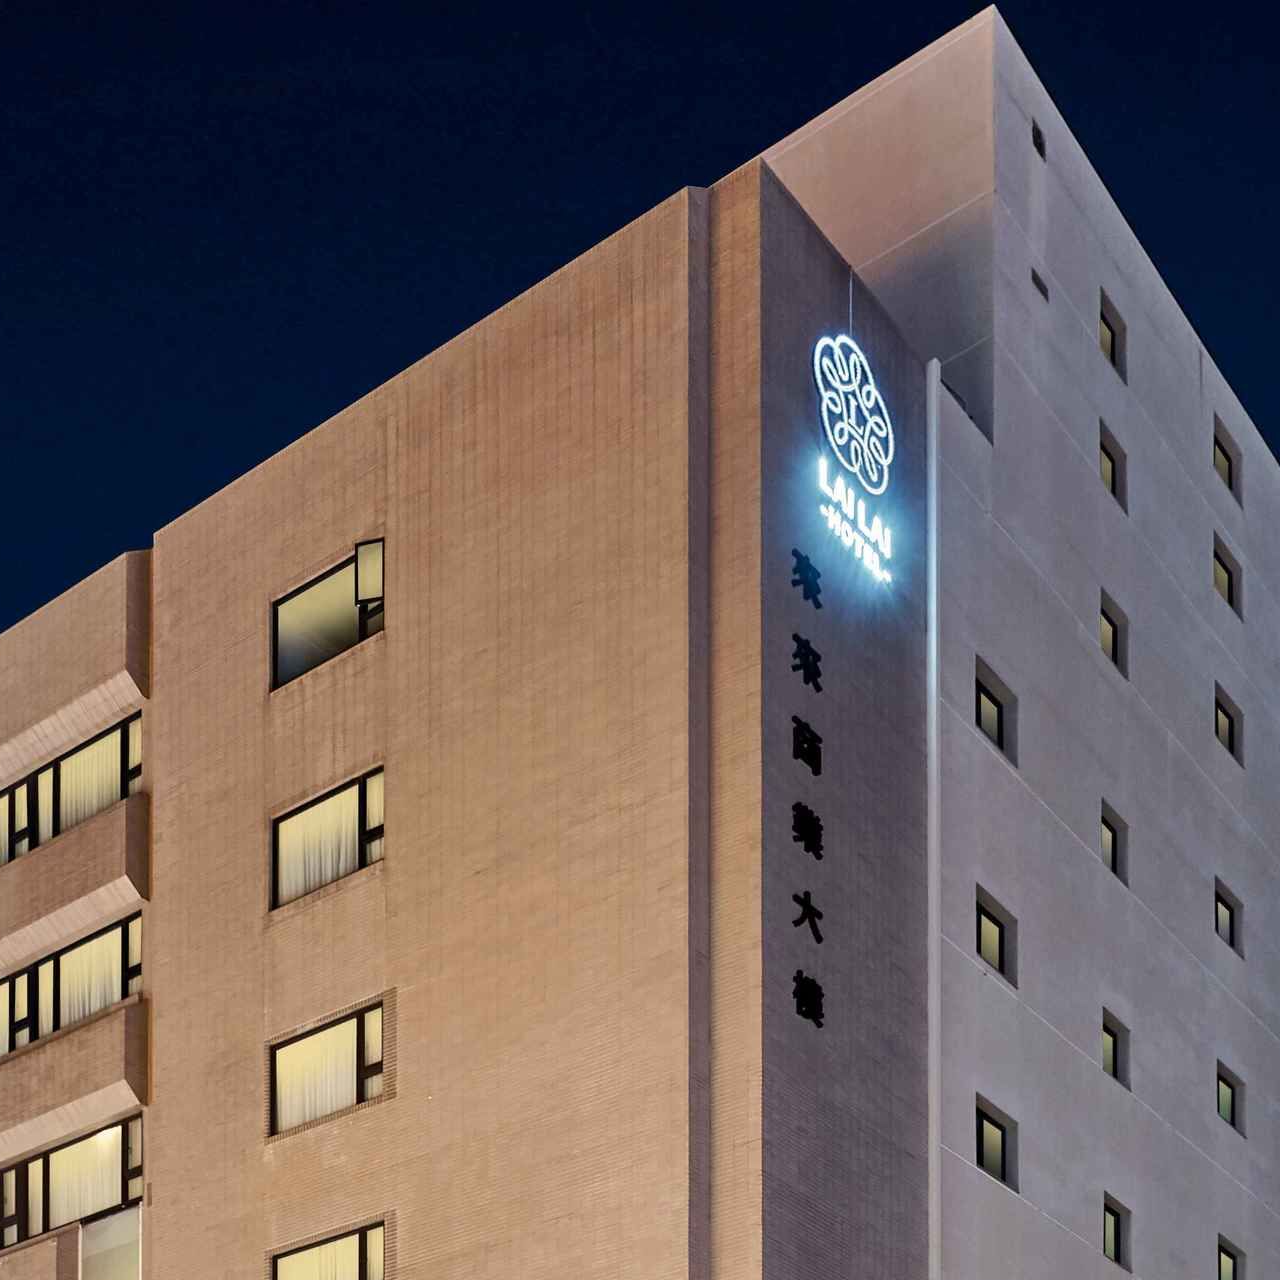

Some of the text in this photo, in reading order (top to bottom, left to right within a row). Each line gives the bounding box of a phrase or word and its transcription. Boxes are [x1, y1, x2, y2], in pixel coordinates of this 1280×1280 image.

[819, 455, 892, 559] LAI LAI
[827, 504, 885, 582] HOTEL
